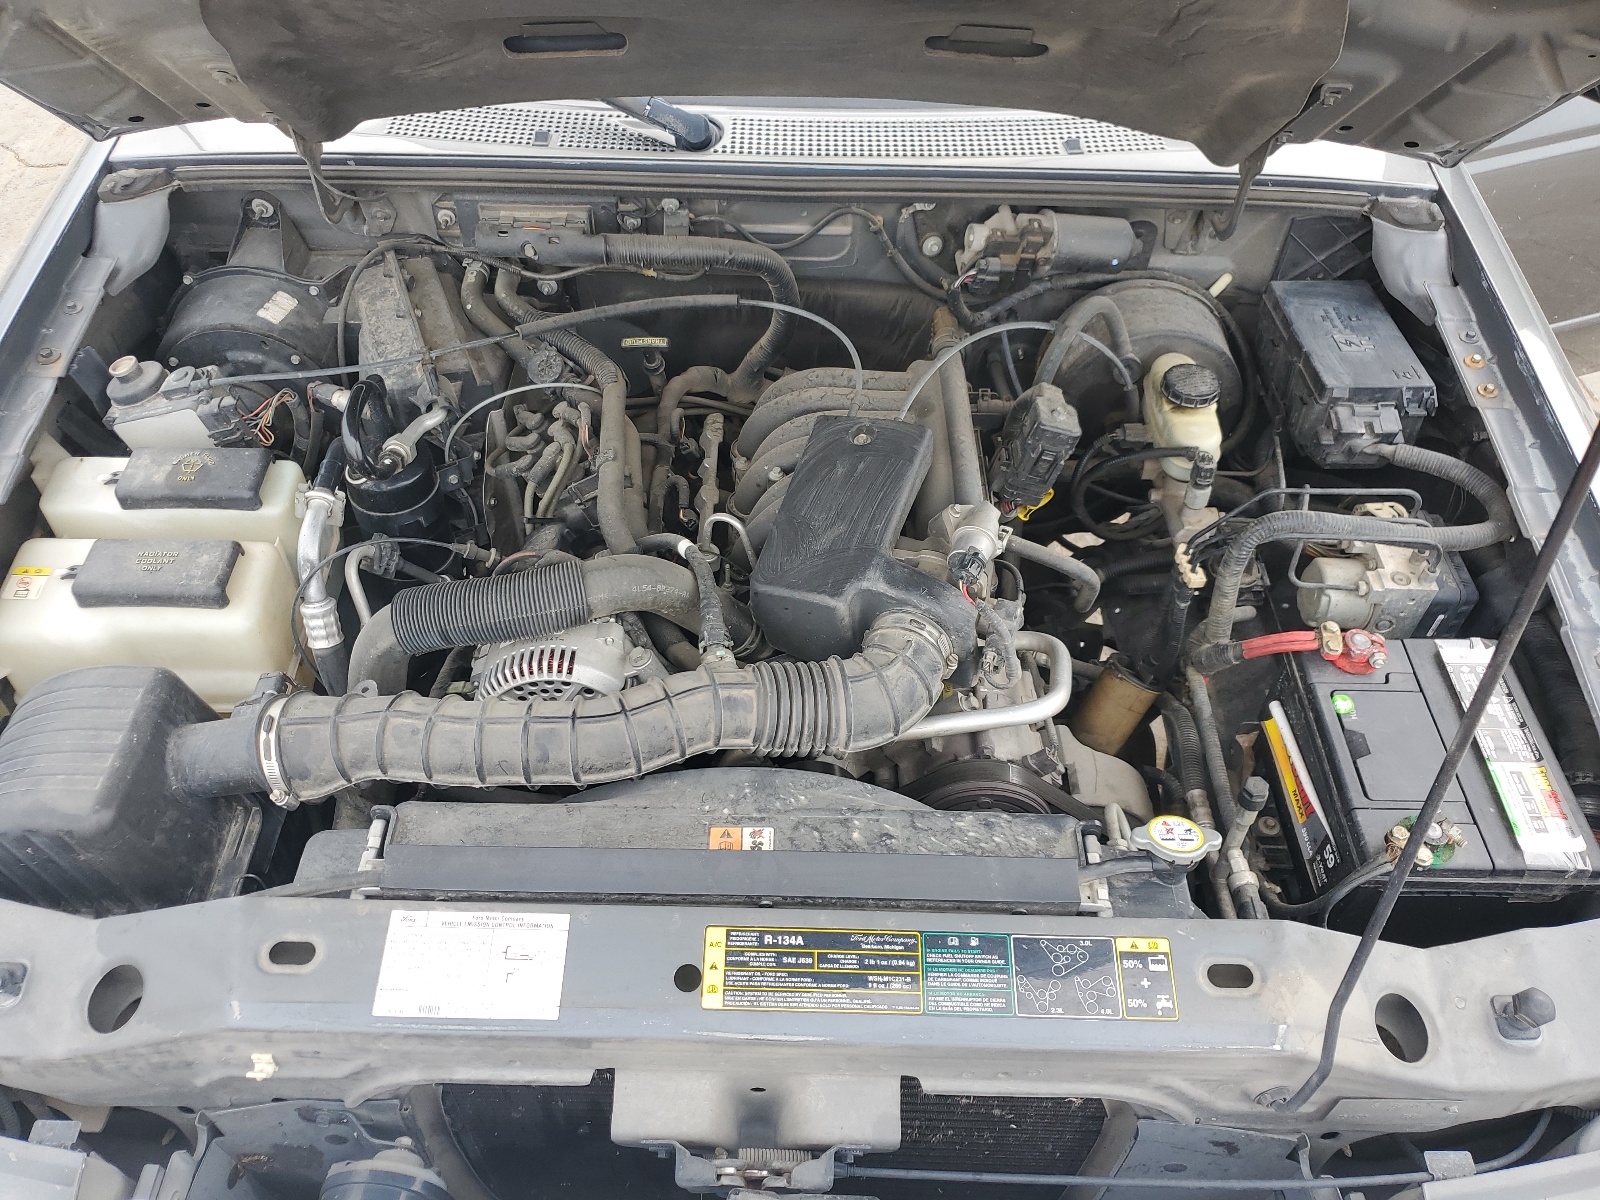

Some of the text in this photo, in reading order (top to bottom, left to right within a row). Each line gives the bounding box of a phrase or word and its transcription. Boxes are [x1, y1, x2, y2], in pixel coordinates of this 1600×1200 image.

[1292, 789, 1304, 820] MAXX
[1323, 844, 1336, 868] 59
[764, 935, 804, 946] R-134A
[1122, 960, 1143, 969] 50%
[1127, 999, 1147, 1008] 50%
